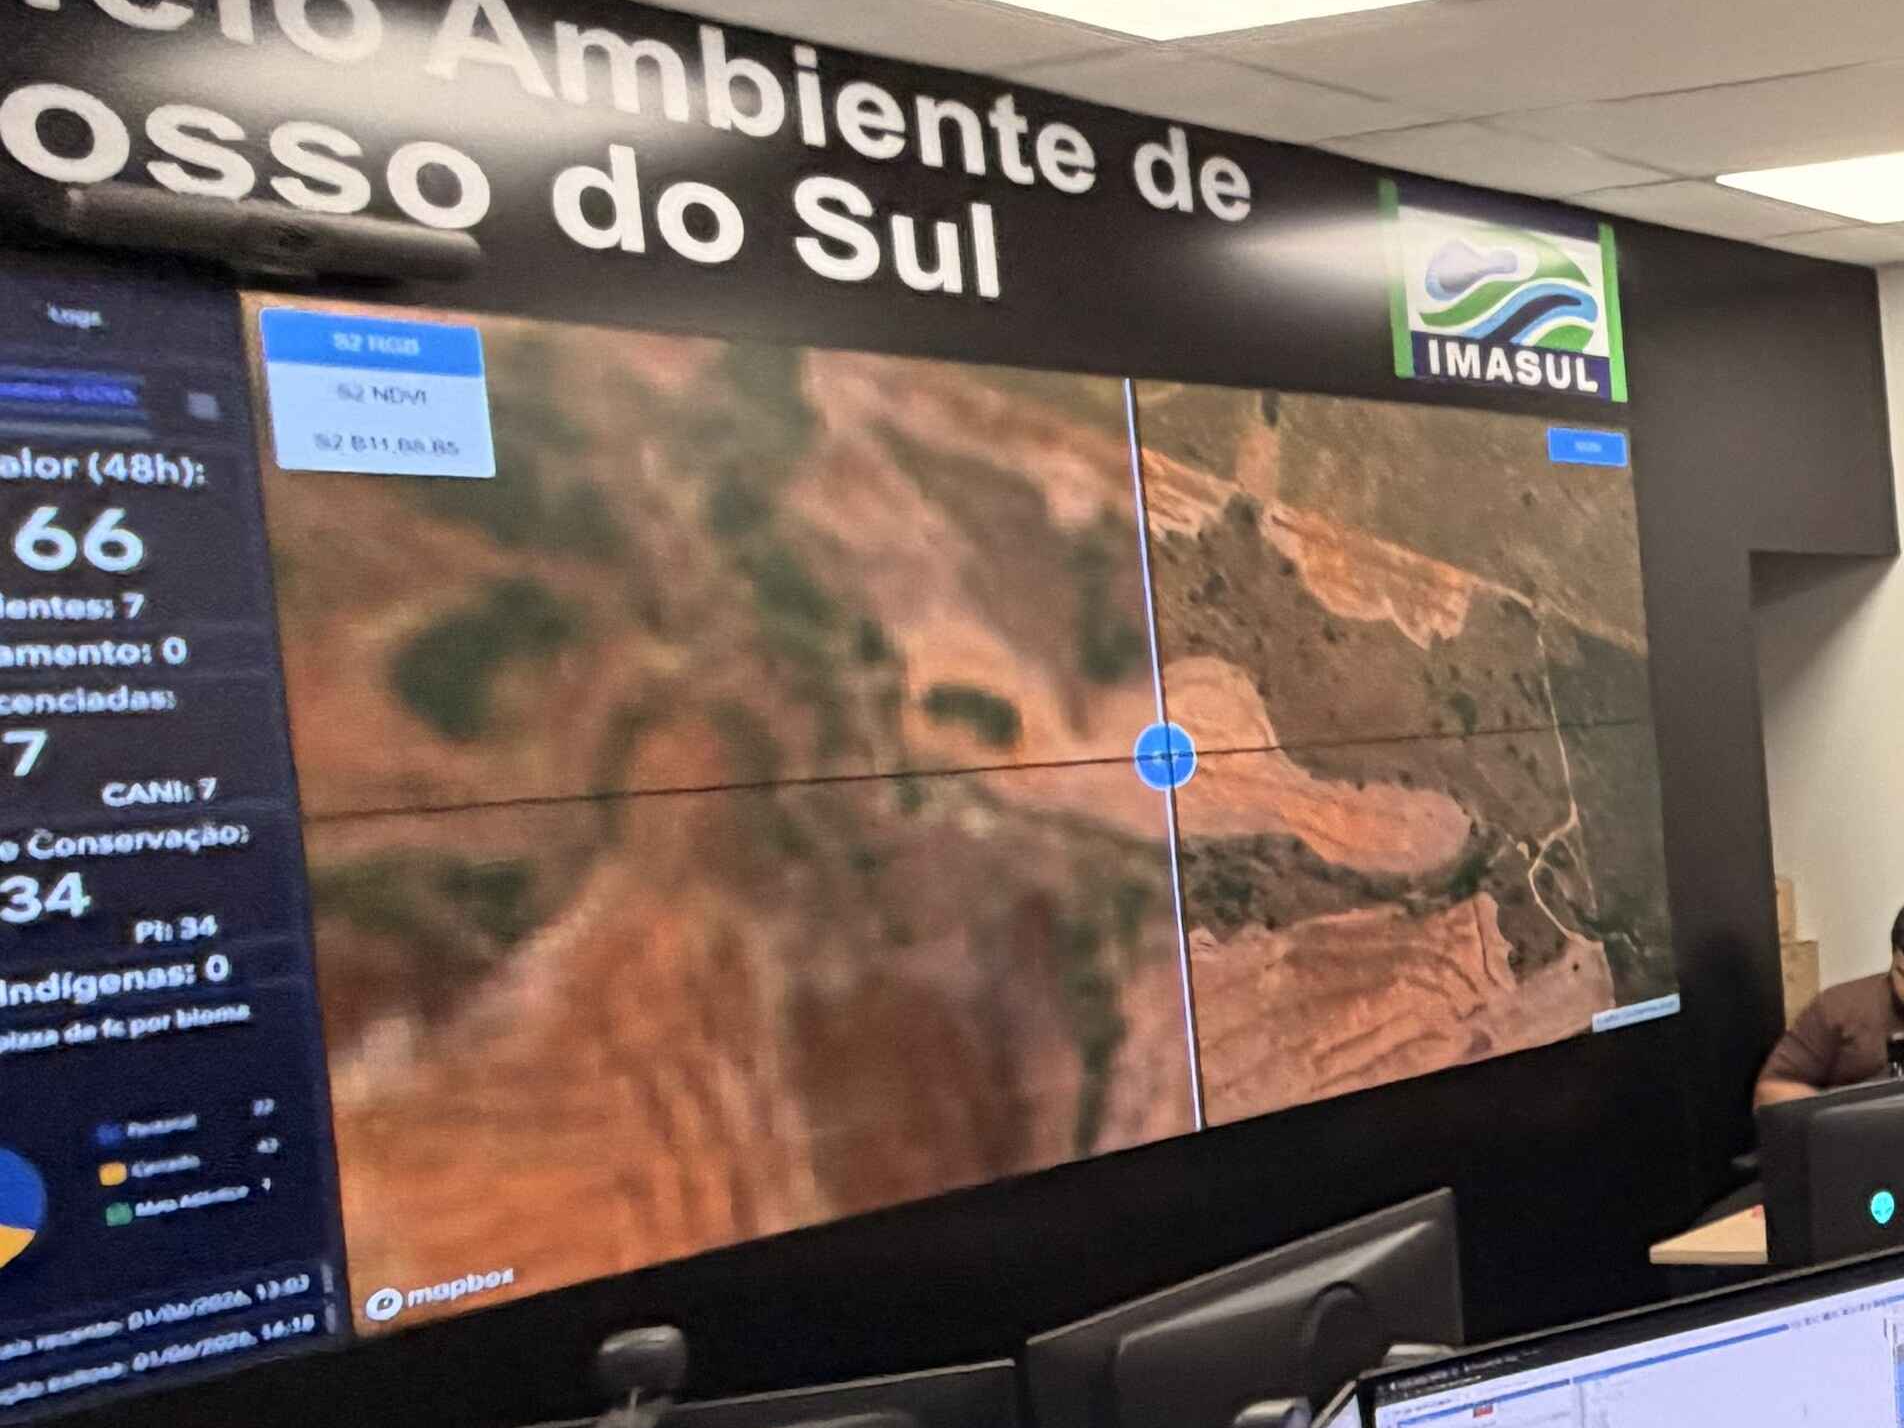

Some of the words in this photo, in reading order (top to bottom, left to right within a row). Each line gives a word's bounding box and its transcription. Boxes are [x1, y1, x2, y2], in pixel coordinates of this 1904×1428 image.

[1, 83, 491, 230] osso
[552, 144, 745, 264] do
[794, 175, 1000, 298] Sul
[1133, 127, 1252, 222] de
[1428, 339, 1599, 393] IMASUL
[88, 452, 206, 489] (48h):
[14, 506, 144, 573] 66
[121, 591, 145, 618] 7
[162, 636, 188, 665] 0
[3, 730, 49, 776] 7
[198, 777, 217, 800] 7
[0, 872, 91, 923] 34
[180, 915, 219, 941] 34
[205, 954, 230, 982] 0
[407, 1268, 514, 1308] mapbox
